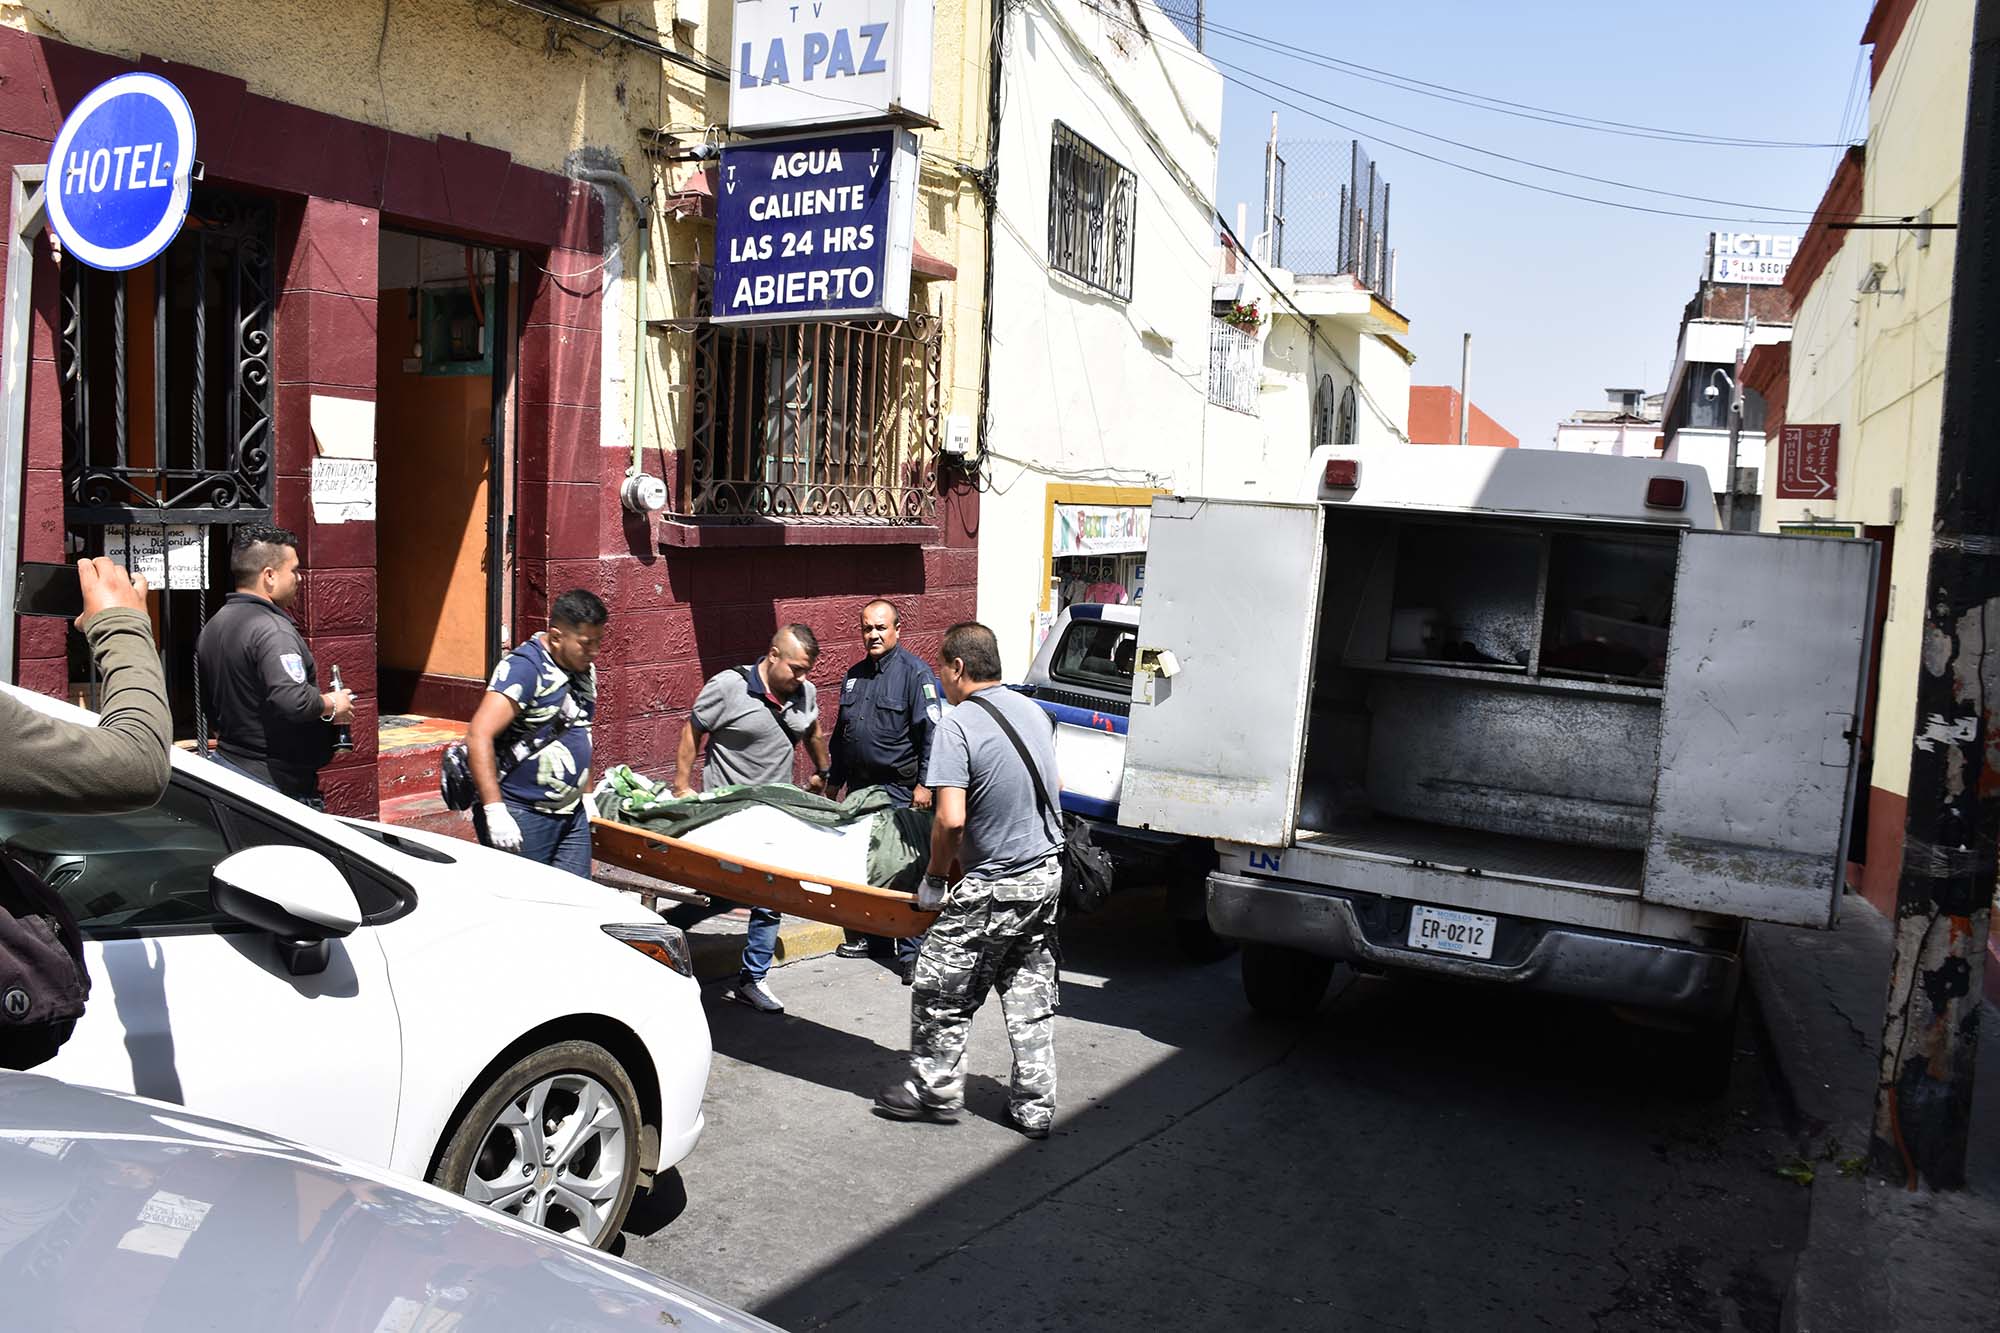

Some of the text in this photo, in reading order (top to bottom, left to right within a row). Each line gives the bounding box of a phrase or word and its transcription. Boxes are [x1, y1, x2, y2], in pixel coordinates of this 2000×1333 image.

[739, 22, 889, 89] LA PAZ
[65, 142, 168, 195] HOTEL
[771, 148, 843, 180] AGUA
[749, 185, 865, 222] CALIENTE
[730, 224, 875, 263] LAS 24 HRS
[1741, 262, 1754, 273] LA
[732, 266, 874, 308] ABIERTO
[1786, 432, 1799, 441] 24
[1787, 443, 1797, 482] HORAS
[1421, 918, 1484, 945] ER-0212
[11, 994, 25, 1012] N
